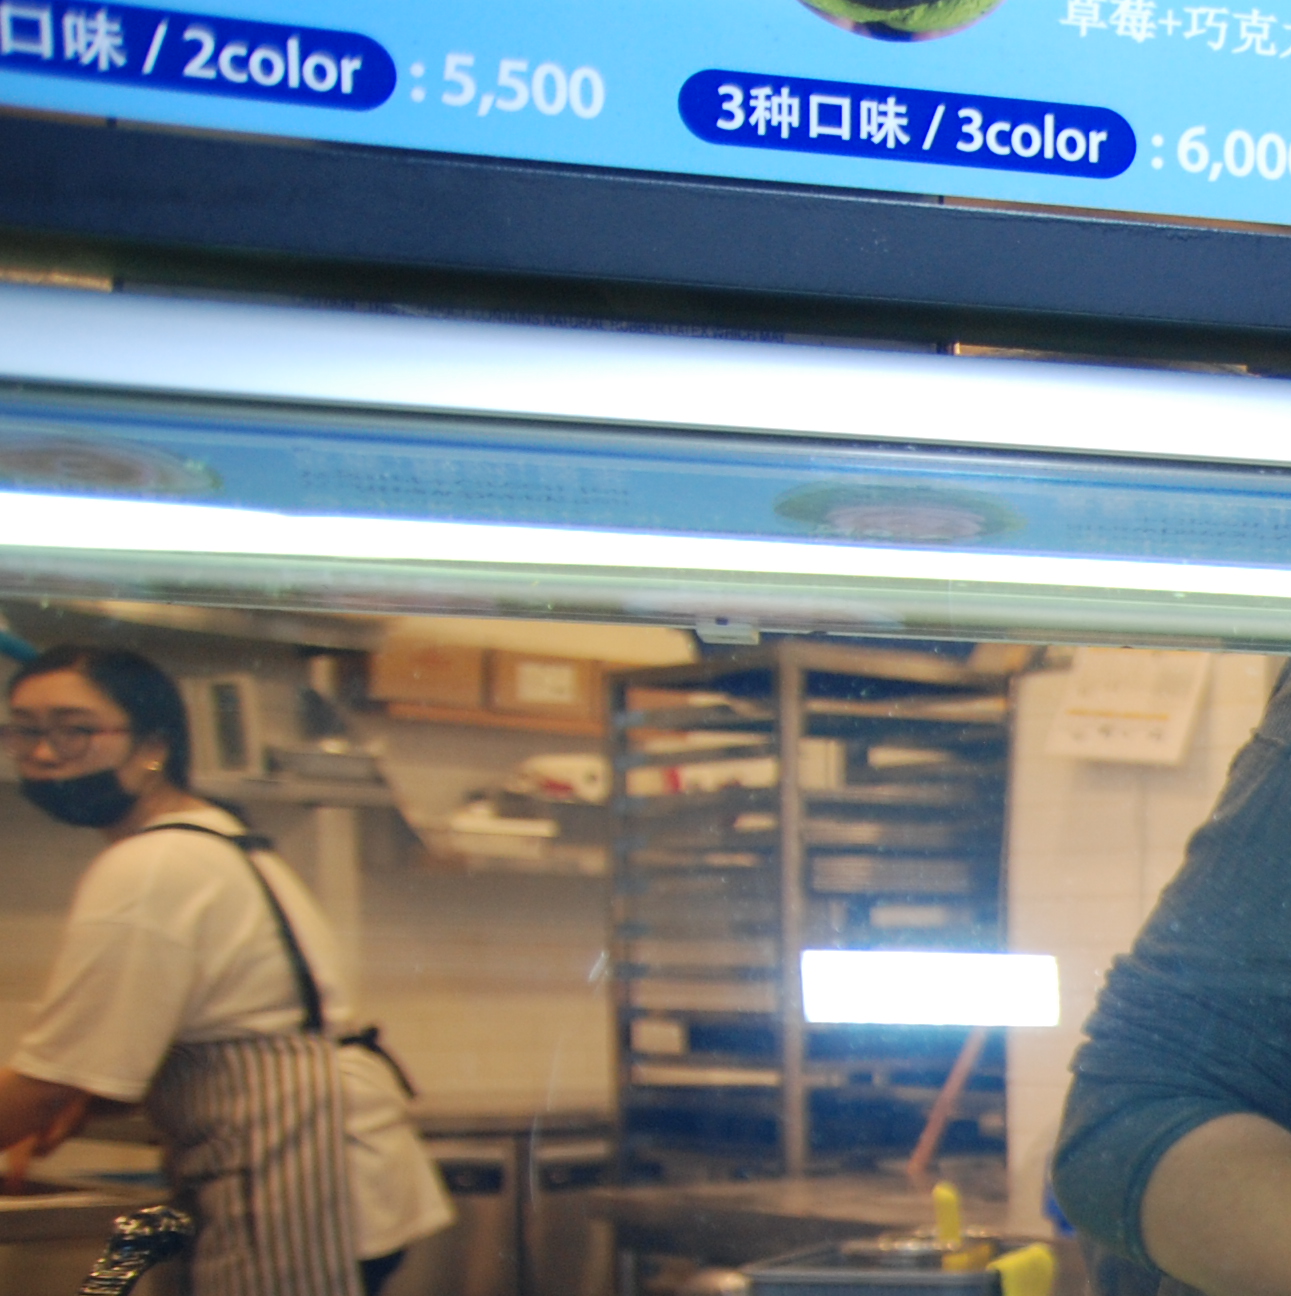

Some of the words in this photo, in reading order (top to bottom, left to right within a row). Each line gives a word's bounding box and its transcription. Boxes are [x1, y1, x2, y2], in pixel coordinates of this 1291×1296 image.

[182, 26, 362, 94] 2color
[441, 53, 604, 119] 5,500
[716, 84, 911, 149] 3种口味
[956, 111, 1108, 164] 3color
